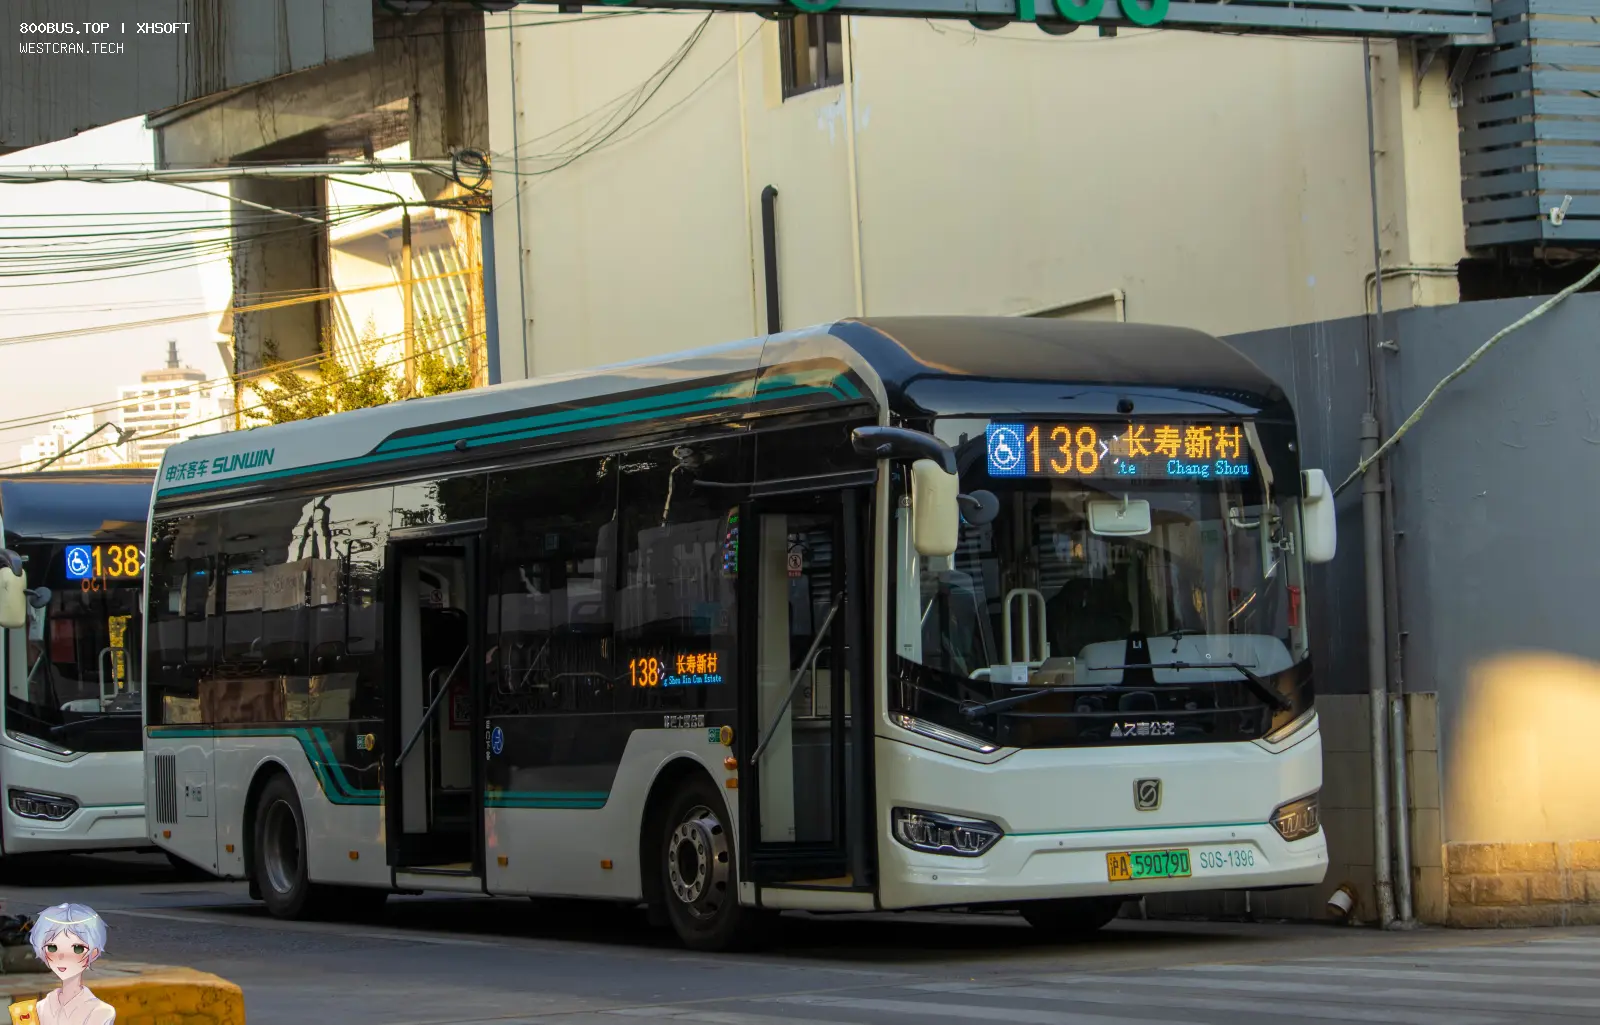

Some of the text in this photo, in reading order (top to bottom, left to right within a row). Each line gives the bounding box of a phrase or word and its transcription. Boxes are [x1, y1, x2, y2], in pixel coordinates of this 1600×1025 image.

[165, 448, 275, 482] 申沃客车 SUNWIN
[1025, 424, 1243, 475] 138 长寿新村
[1166, 459, 1210, 477] Chang
[1214, 459, 1250, 476] Shou
[91, 544, 141, 577] 138
[629, 652, 718, 687] 138 长寿新村
[704, 673, 722, 683] Estate
